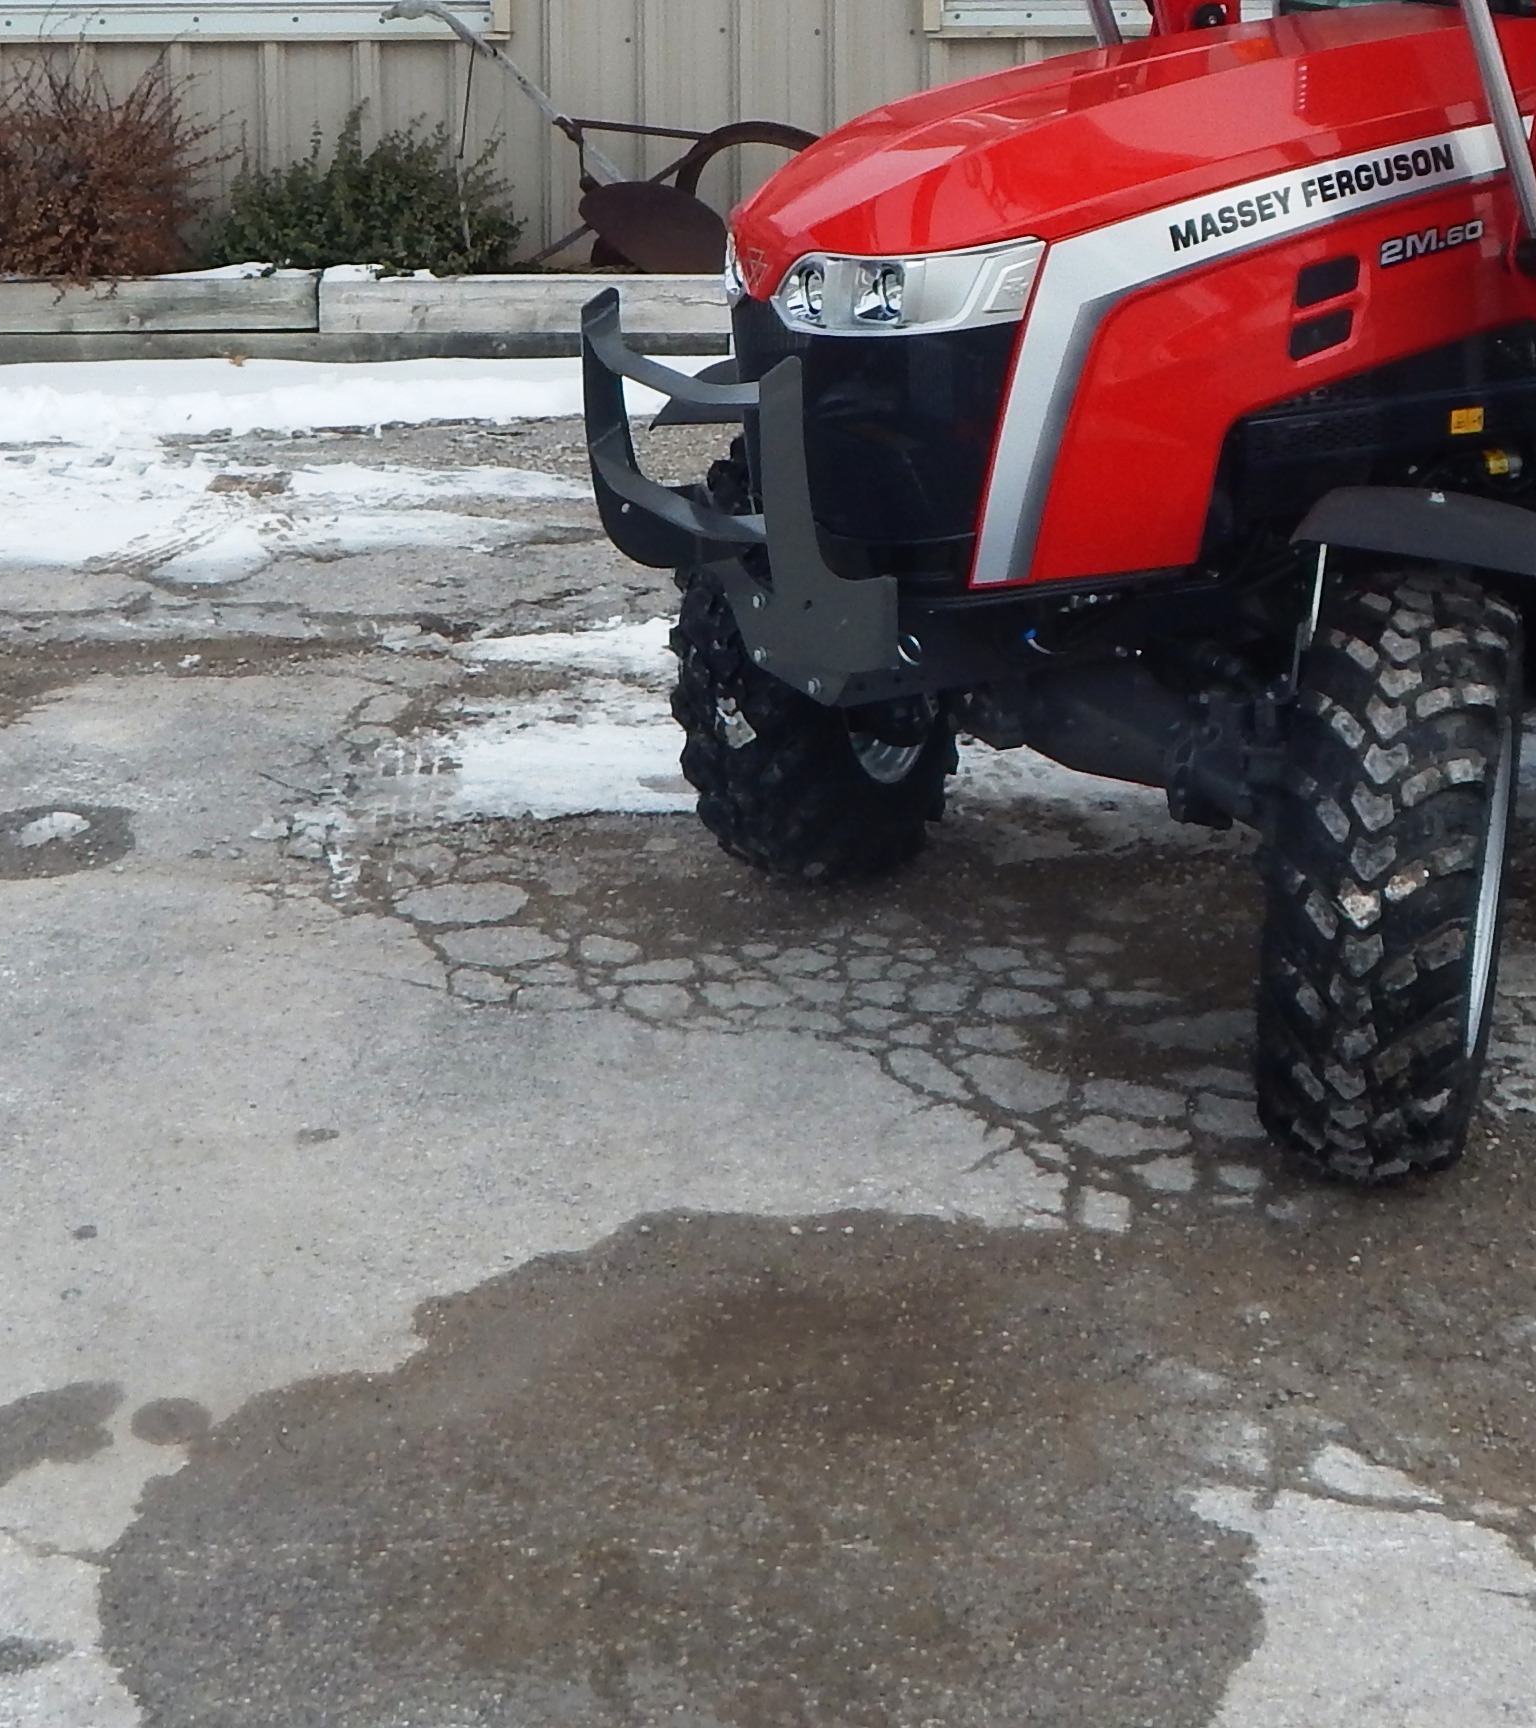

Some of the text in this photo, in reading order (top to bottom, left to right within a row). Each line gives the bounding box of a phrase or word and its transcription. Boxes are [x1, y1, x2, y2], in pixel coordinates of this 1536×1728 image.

[1168, 143, 1455, 252] MASSEY FERGUSON
[1379, 219, 1484, 269] 2M.60
